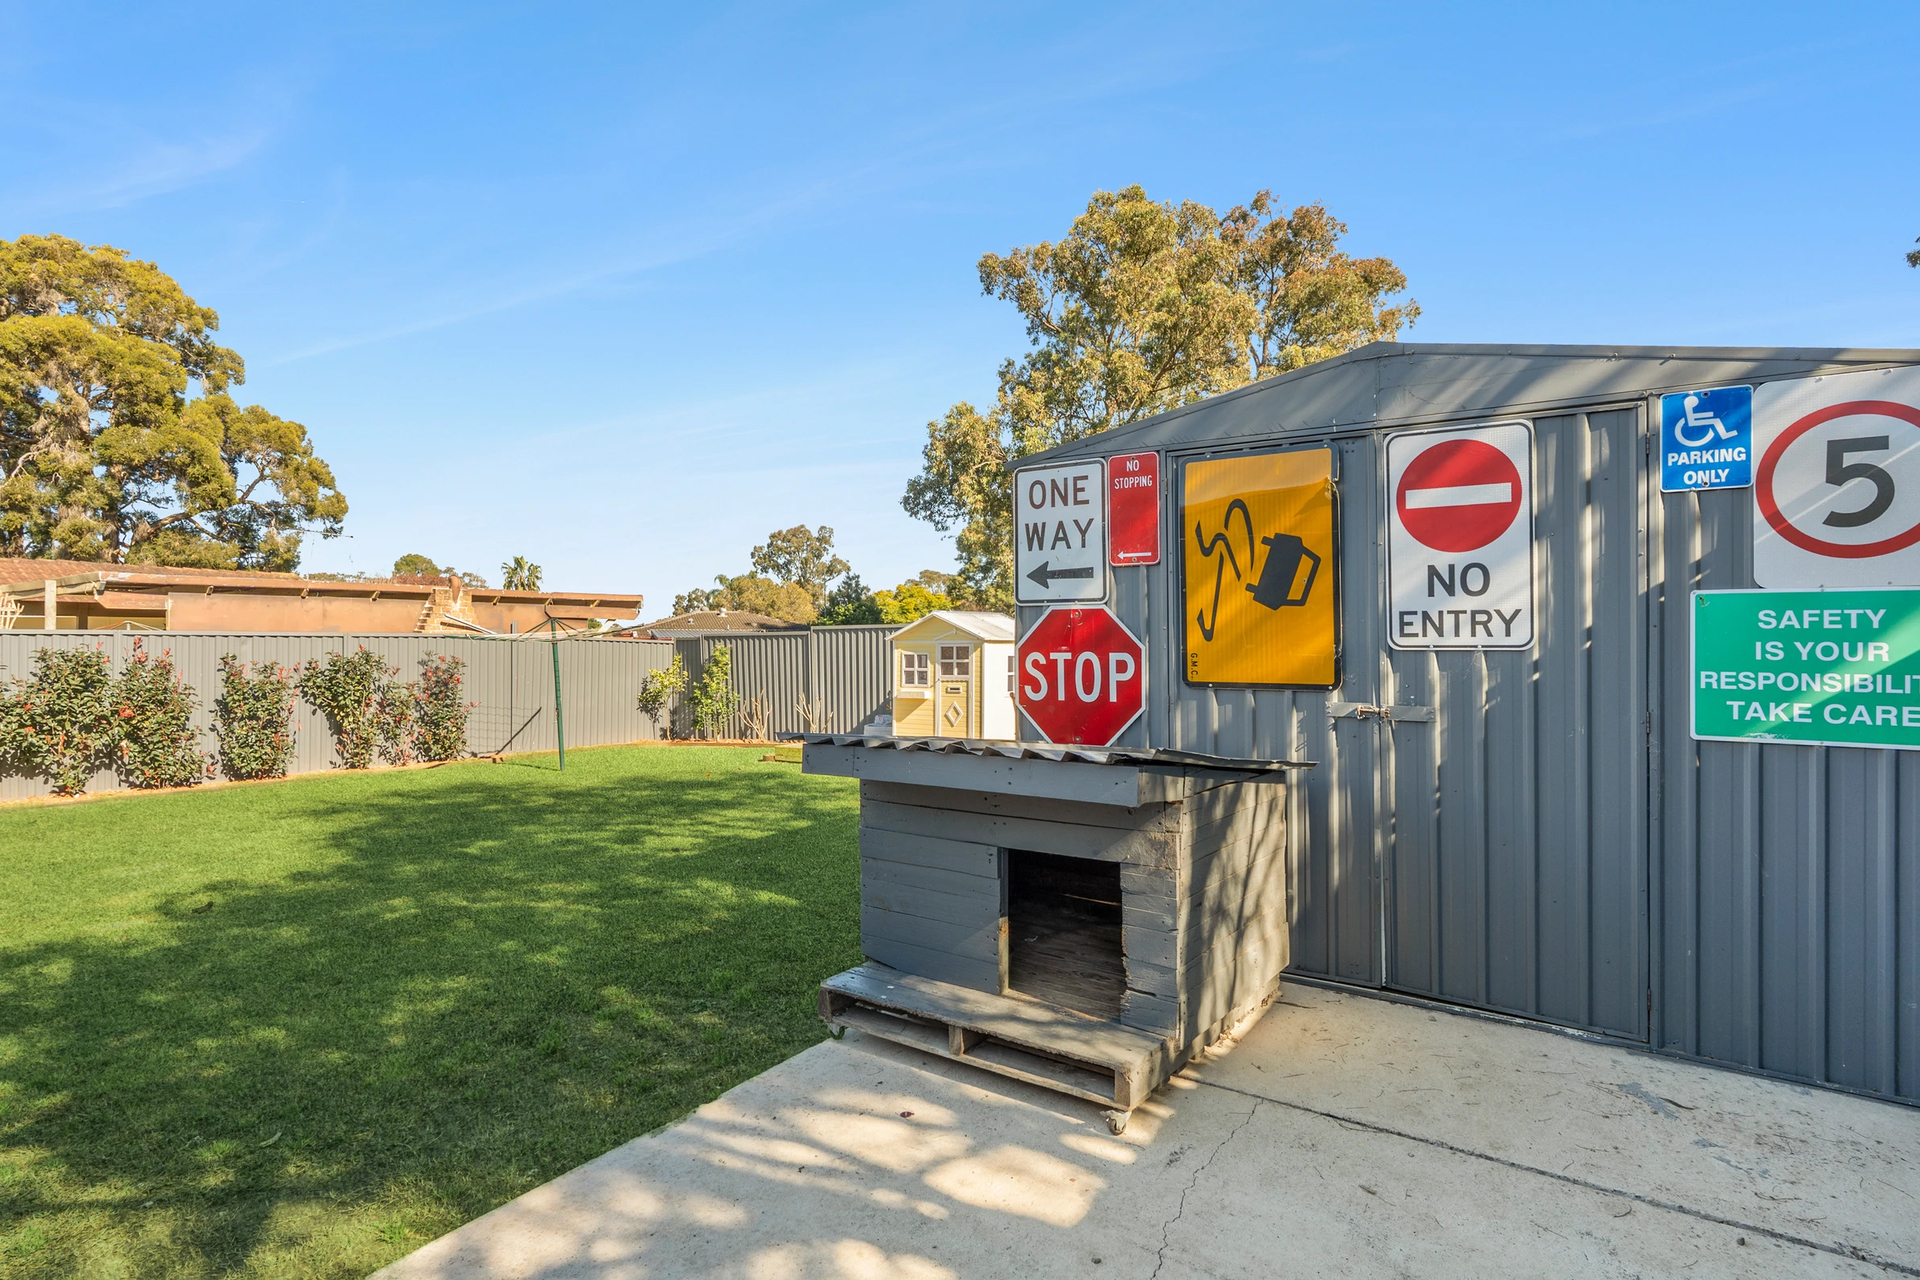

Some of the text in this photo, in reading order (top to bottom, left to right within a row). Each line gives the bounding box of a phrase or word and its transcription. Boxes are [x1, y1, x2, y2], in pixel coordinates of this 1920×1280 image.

[1126, 460, 1140, 472] NO
[1667, 447, 1747, 467] PARKING
[1114, 475, 1153, 490] STOPPING
[1683, 468, 1730, 486] ONLY
[1822, 435, 1896, 528] 5
[1028, 474, 1090, 510] ONE
[1024, 518, 1095, 552] WAY
[1427, 562, 1491, 598] NO
[1398, 608, 1523, 638] ENTRY
[1757, 608, 1887, 630] SAFETY
[1755, 641, 1890, 662] IS YOUR
[1024, 651, 1136, 703] STOP
[1726, 701, 1920, 728] TAKE CARE
